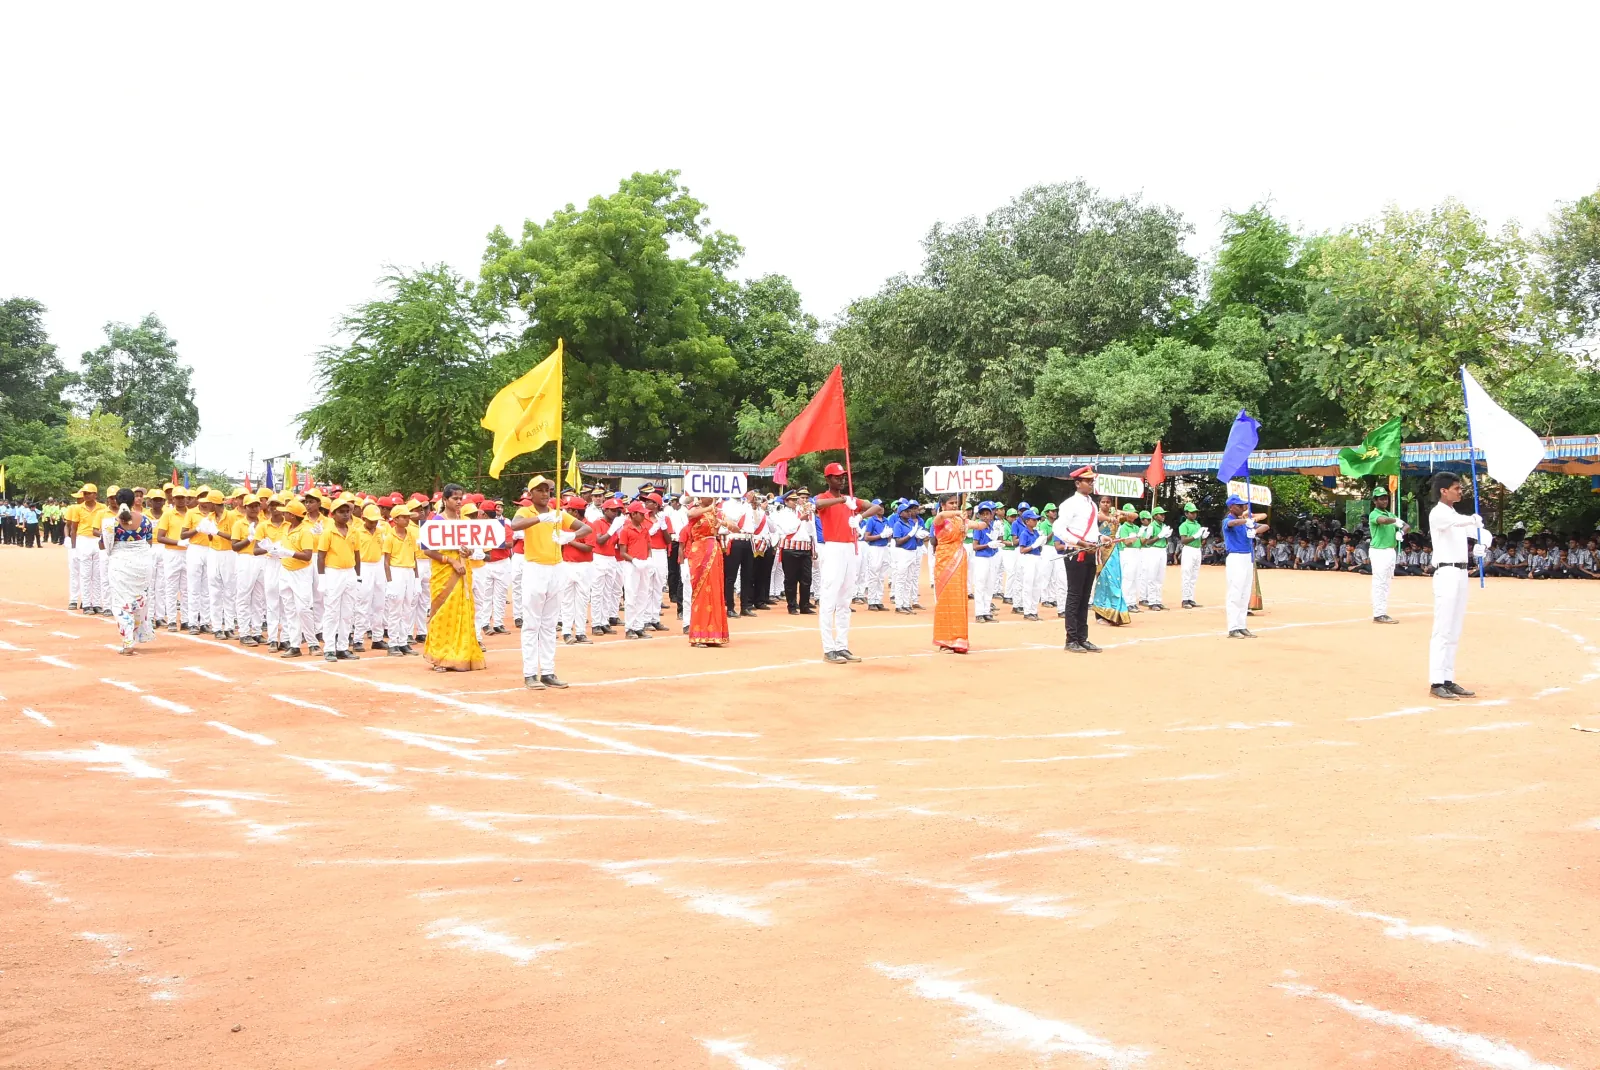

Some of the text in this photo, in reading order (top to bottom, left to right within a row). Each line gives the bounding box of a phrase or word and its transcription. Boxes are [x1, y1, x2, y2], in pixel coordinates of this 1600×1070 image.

[692, 474, 742, 494] CHOLA
[935, 469, 993, 491] LMHSS
[1098, 476, 1139, 496] PANDIYA
[1231, 482, 1269, 504] PALAVA
[427, 524, 498, 547] CHERA
